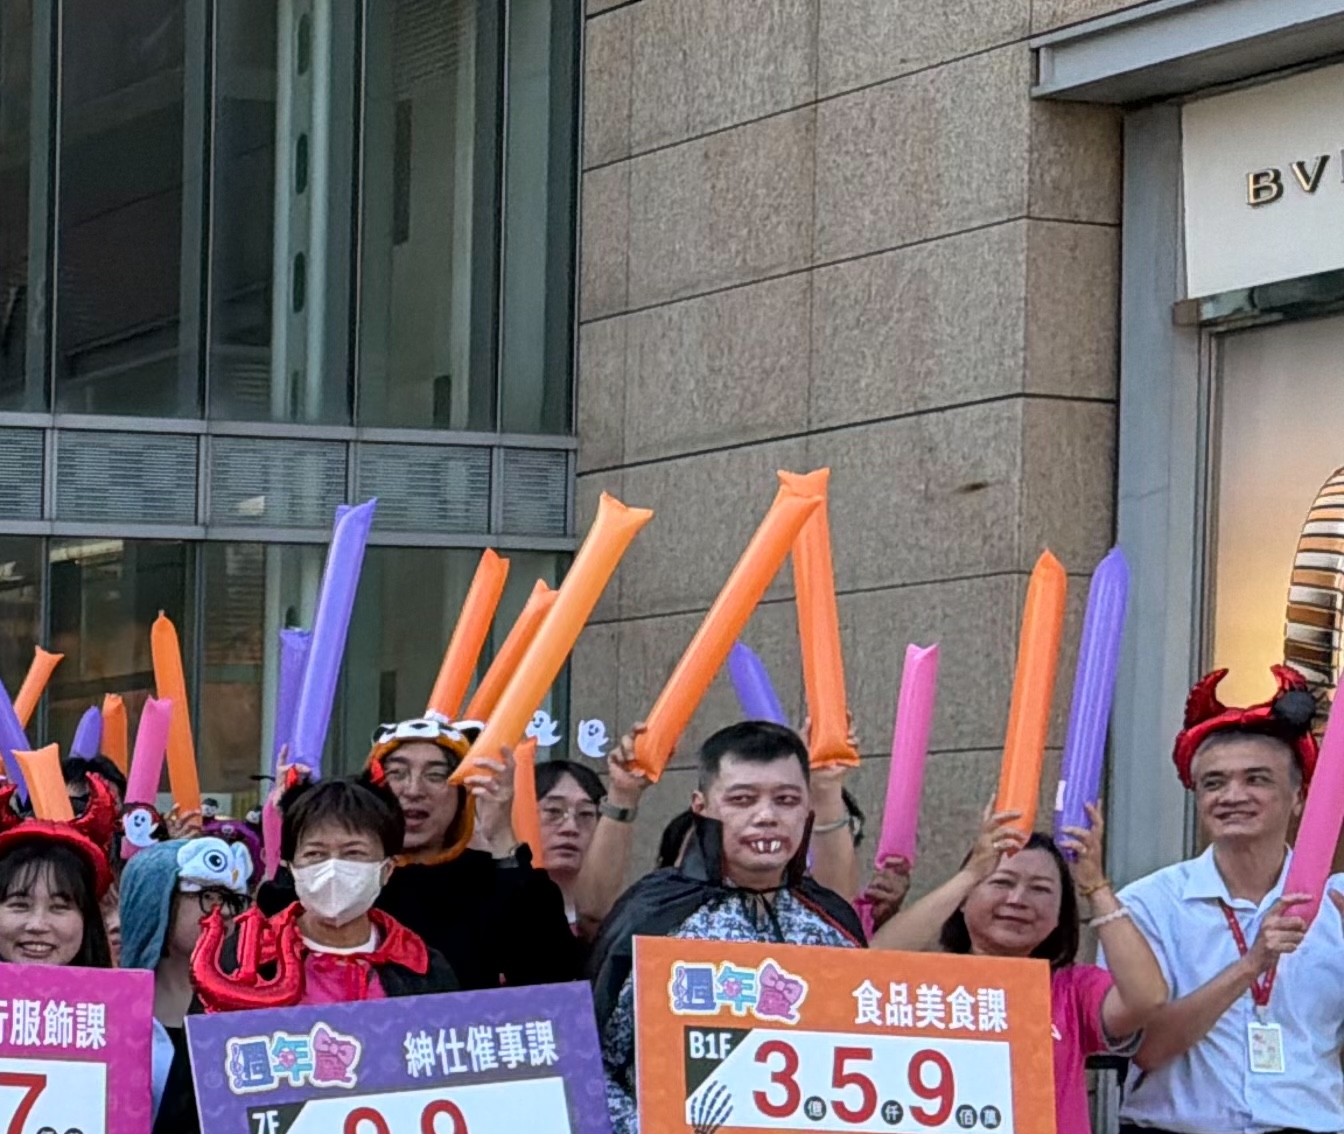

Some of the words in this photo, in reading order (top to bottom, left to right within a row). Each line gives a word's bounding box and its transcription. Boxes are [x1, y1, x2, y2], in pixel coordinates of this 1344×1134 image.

[1247, 148, 1344, 208] BV
[852, 979, 1008, 1033] 食品美食課
[403, 1020, 560, 1078] 紳仕催事課
[689, 1031, 732, 1059] B1F
